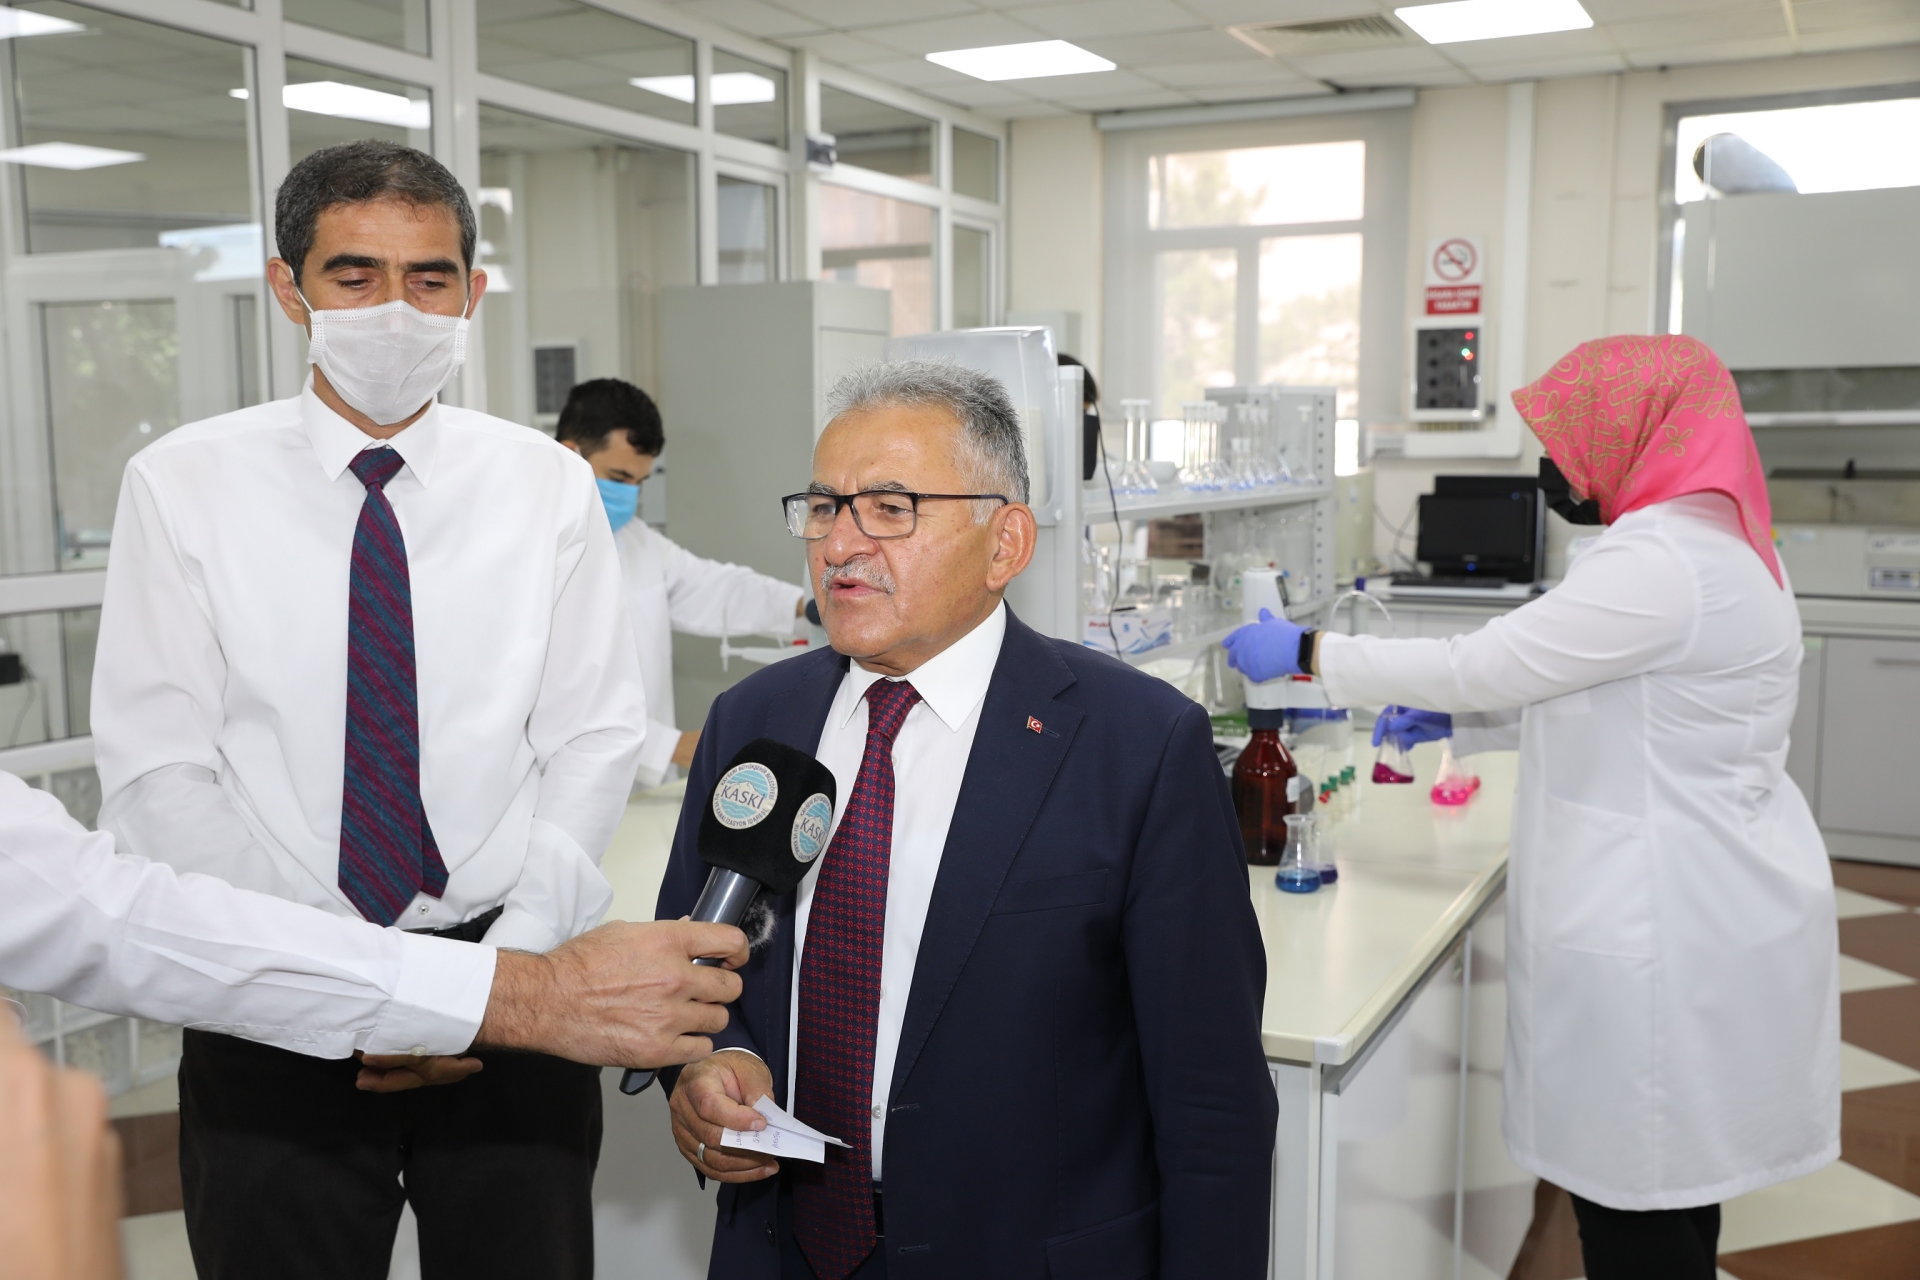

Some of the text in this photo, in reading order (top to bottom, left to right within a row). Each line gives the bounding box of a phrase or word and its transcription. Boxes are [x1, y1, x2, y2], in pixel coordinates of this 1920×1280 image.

[720, 764, 776, 801] KAYSERİ BÜYÜKŞEHİR BELEDİYESİ
[720, 785, 766, 809] KASKİ
[715, 806, 747, 827] KANALİZASYON
[747, 808, 768, 825] İDARESİ
